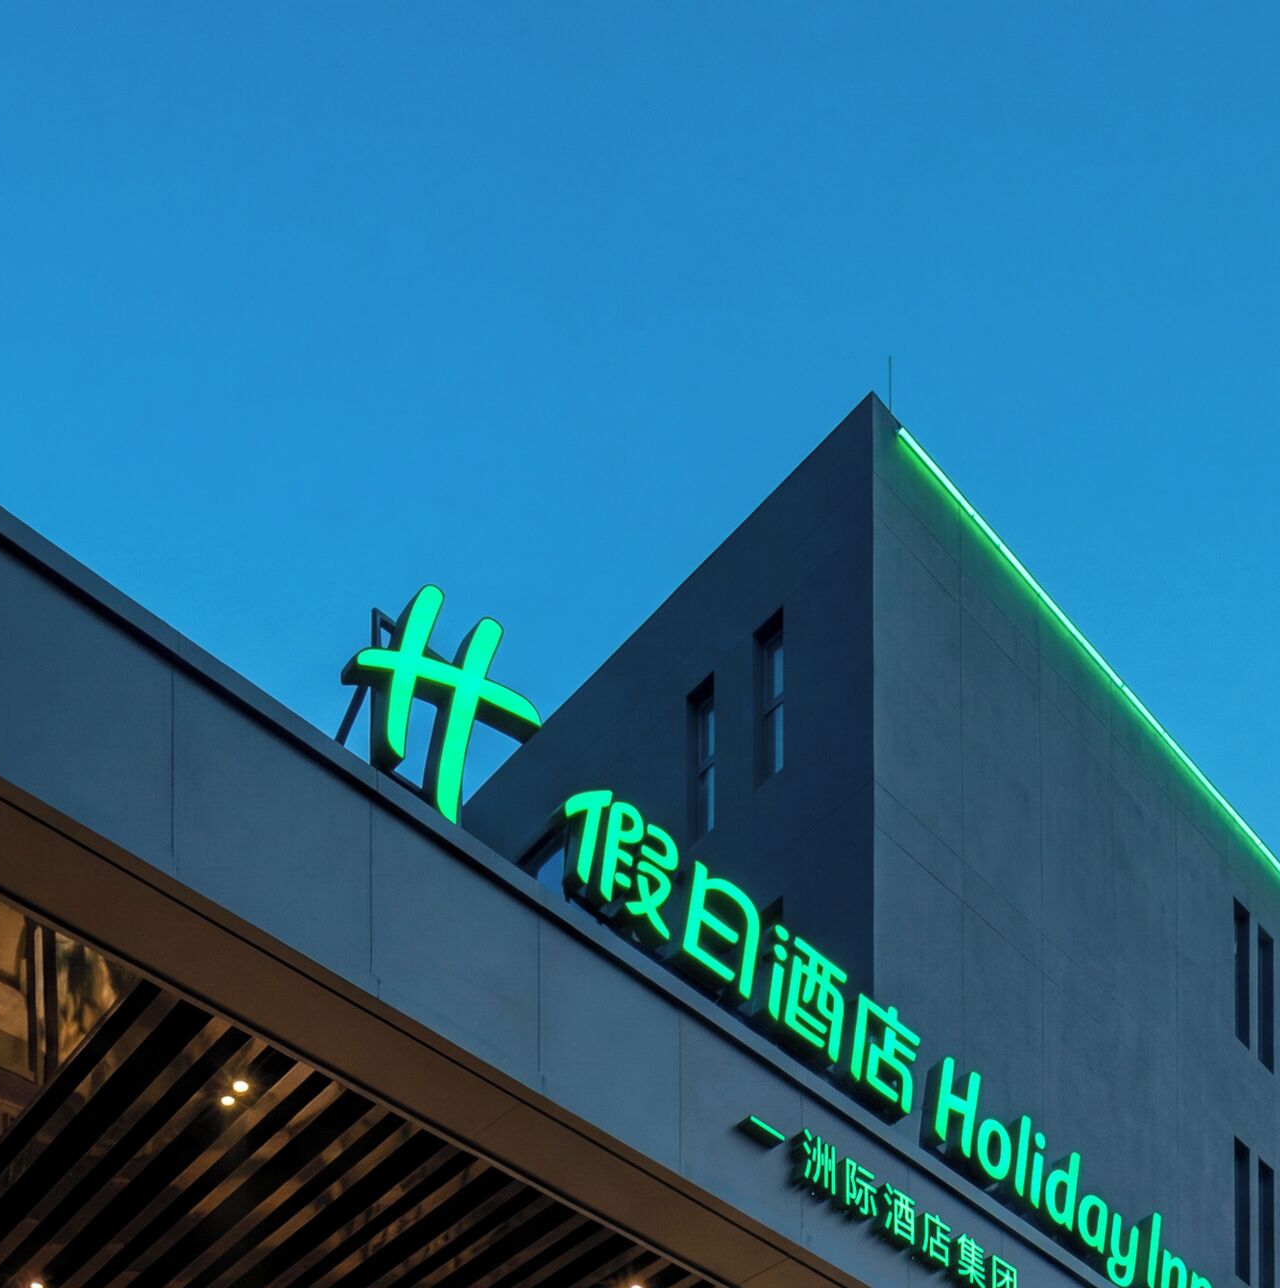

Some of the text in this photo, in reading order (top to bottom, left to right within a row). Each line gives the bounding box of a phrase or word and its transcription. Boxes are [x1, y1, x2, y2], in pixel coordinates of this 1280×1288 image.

[565, 790, 921, 1115] 假日酒店
[935, 1057, 1139, 1287] Holiday
